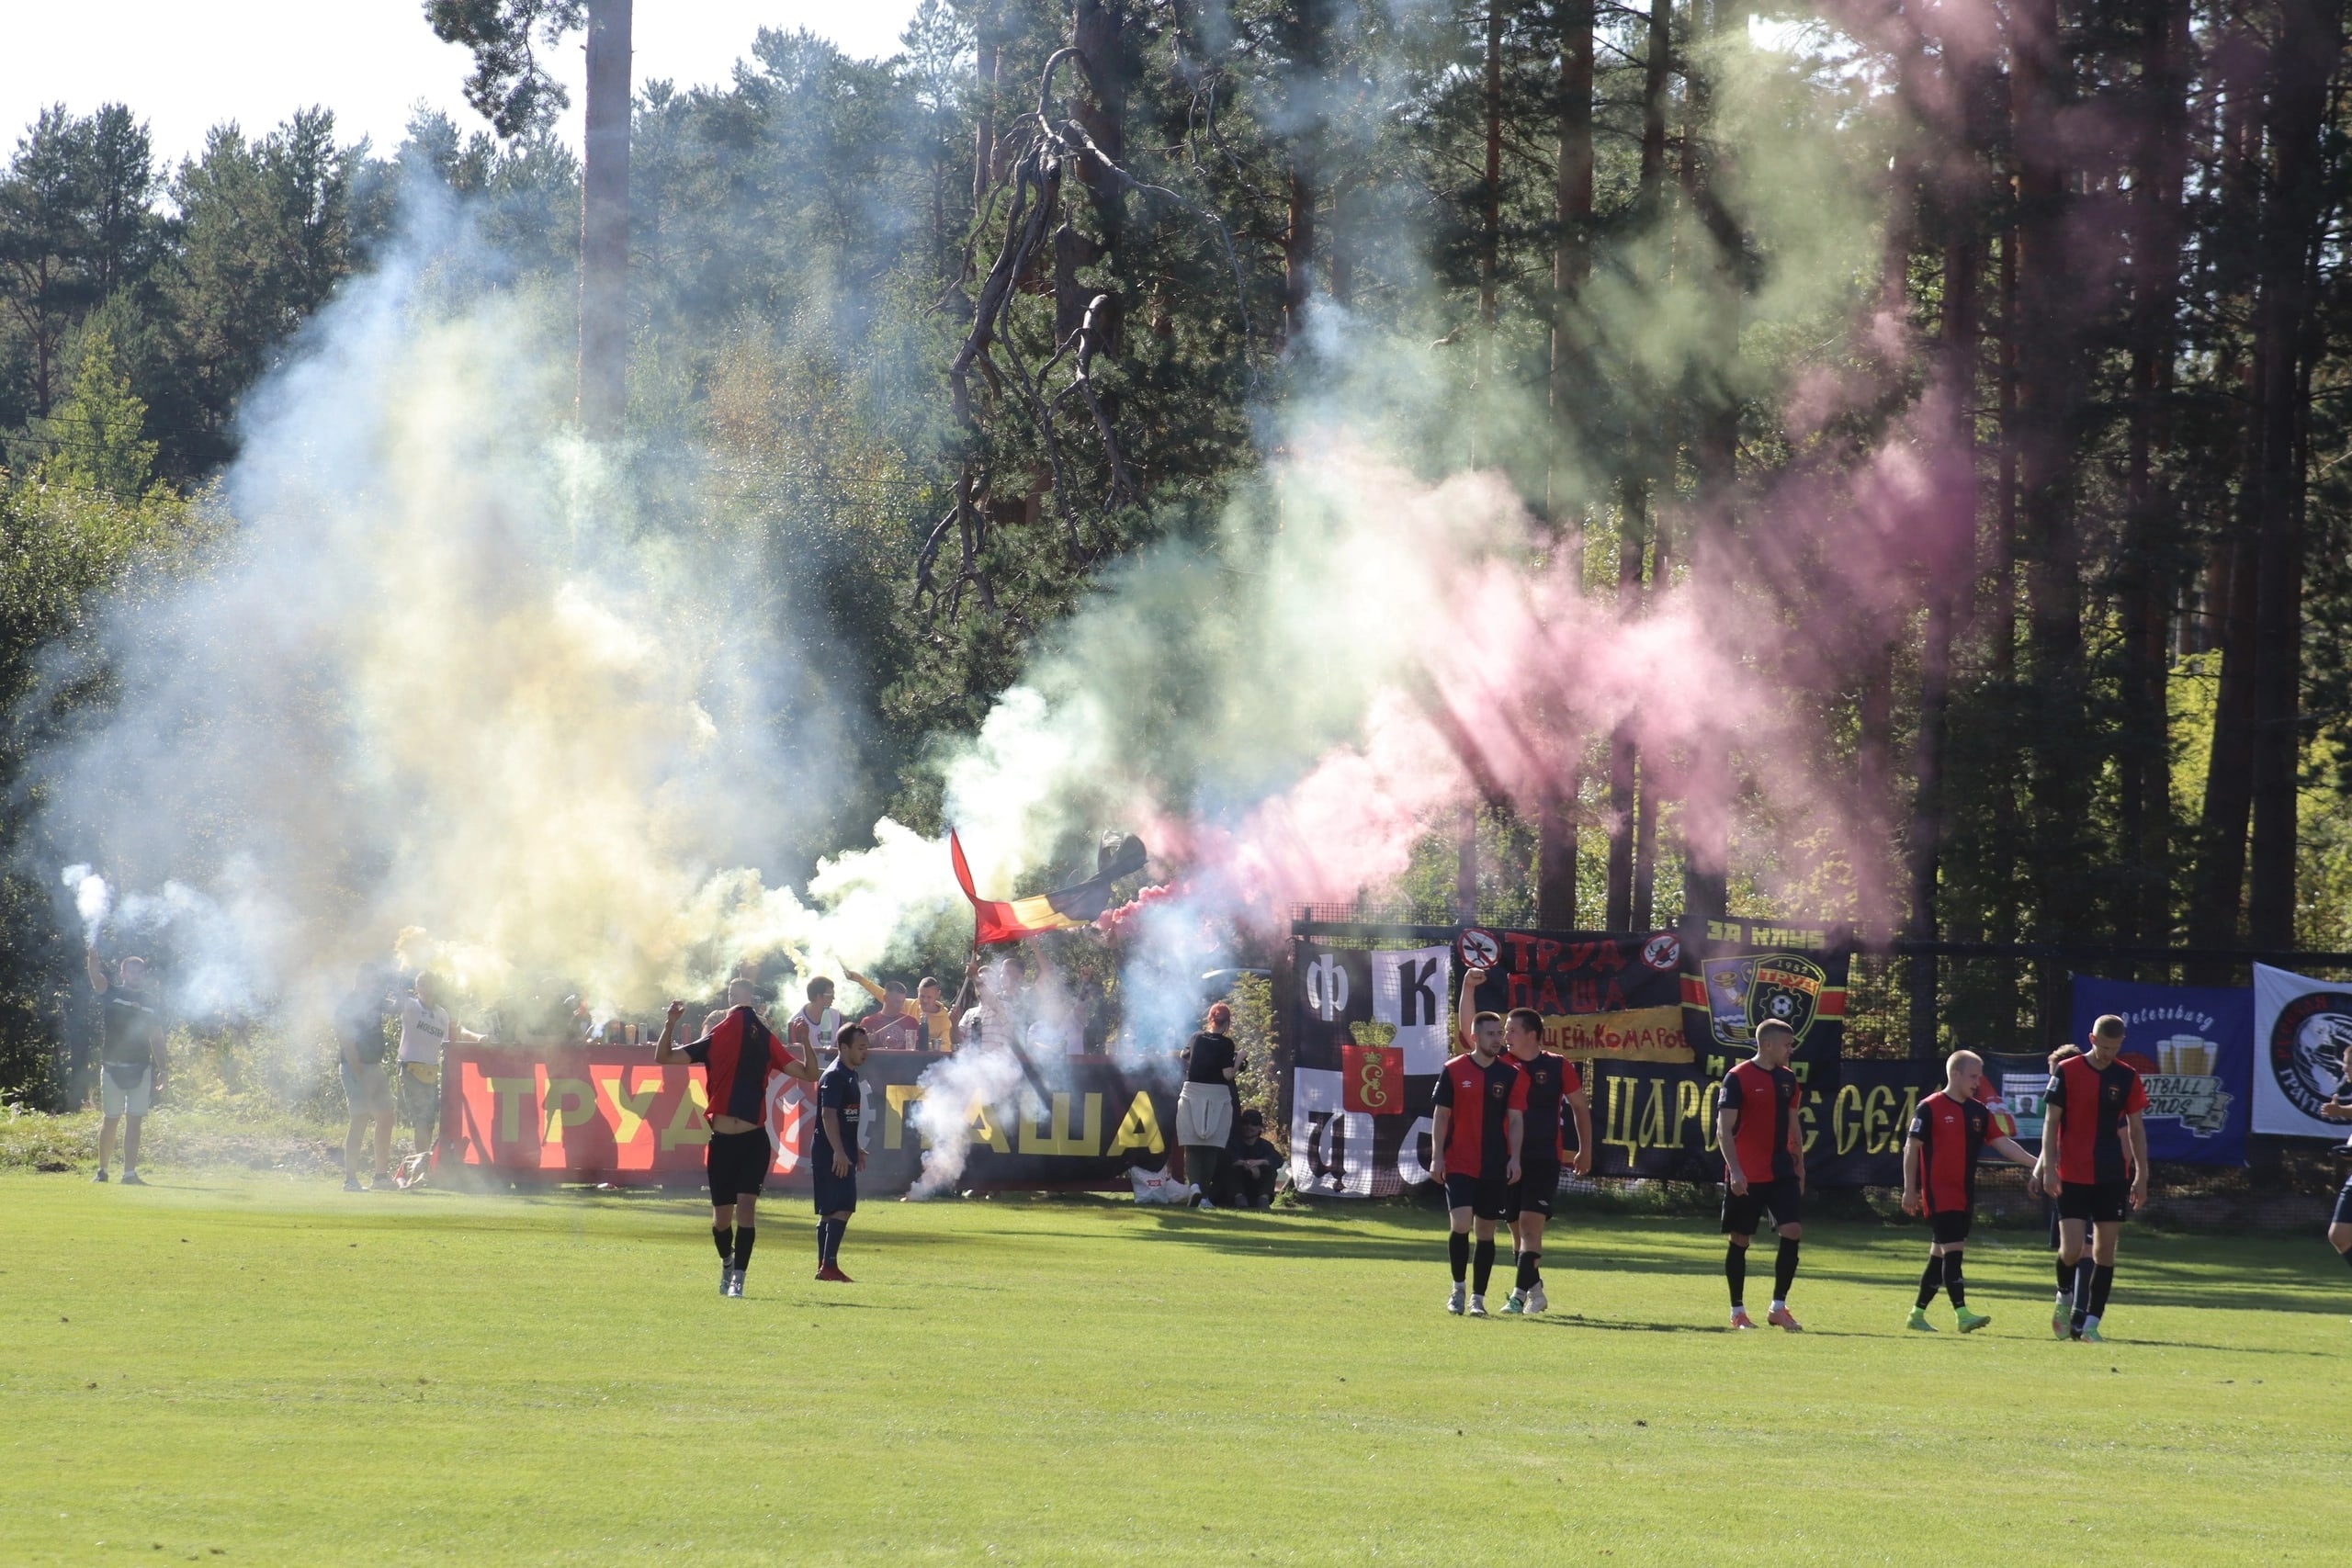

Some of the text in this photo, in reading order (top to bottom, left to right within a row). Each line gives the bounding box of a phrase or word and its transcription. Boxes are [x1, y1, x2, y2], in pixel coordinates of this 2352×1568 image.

[1504, 932, 1627, 972] ТРУД
[1706, 920, 1826, 950] ЗА КЛУБ
[1762, 969, 1816, 996] ТРУД
[1777, 960, 1808, 974] 1952
[1508, 973, 1628, 1014] ПАША
[2121, 1004, 2214, 1032] Petersburg
[2143, 1077, 2201, 1096] OTBALL
[487, 1076, 710, 1152] ТРУД
[884, 1084, 1164, 1157] ПАША
[1601, 1075, 1942, 1168] ЦАРСЕ СЕЛ
